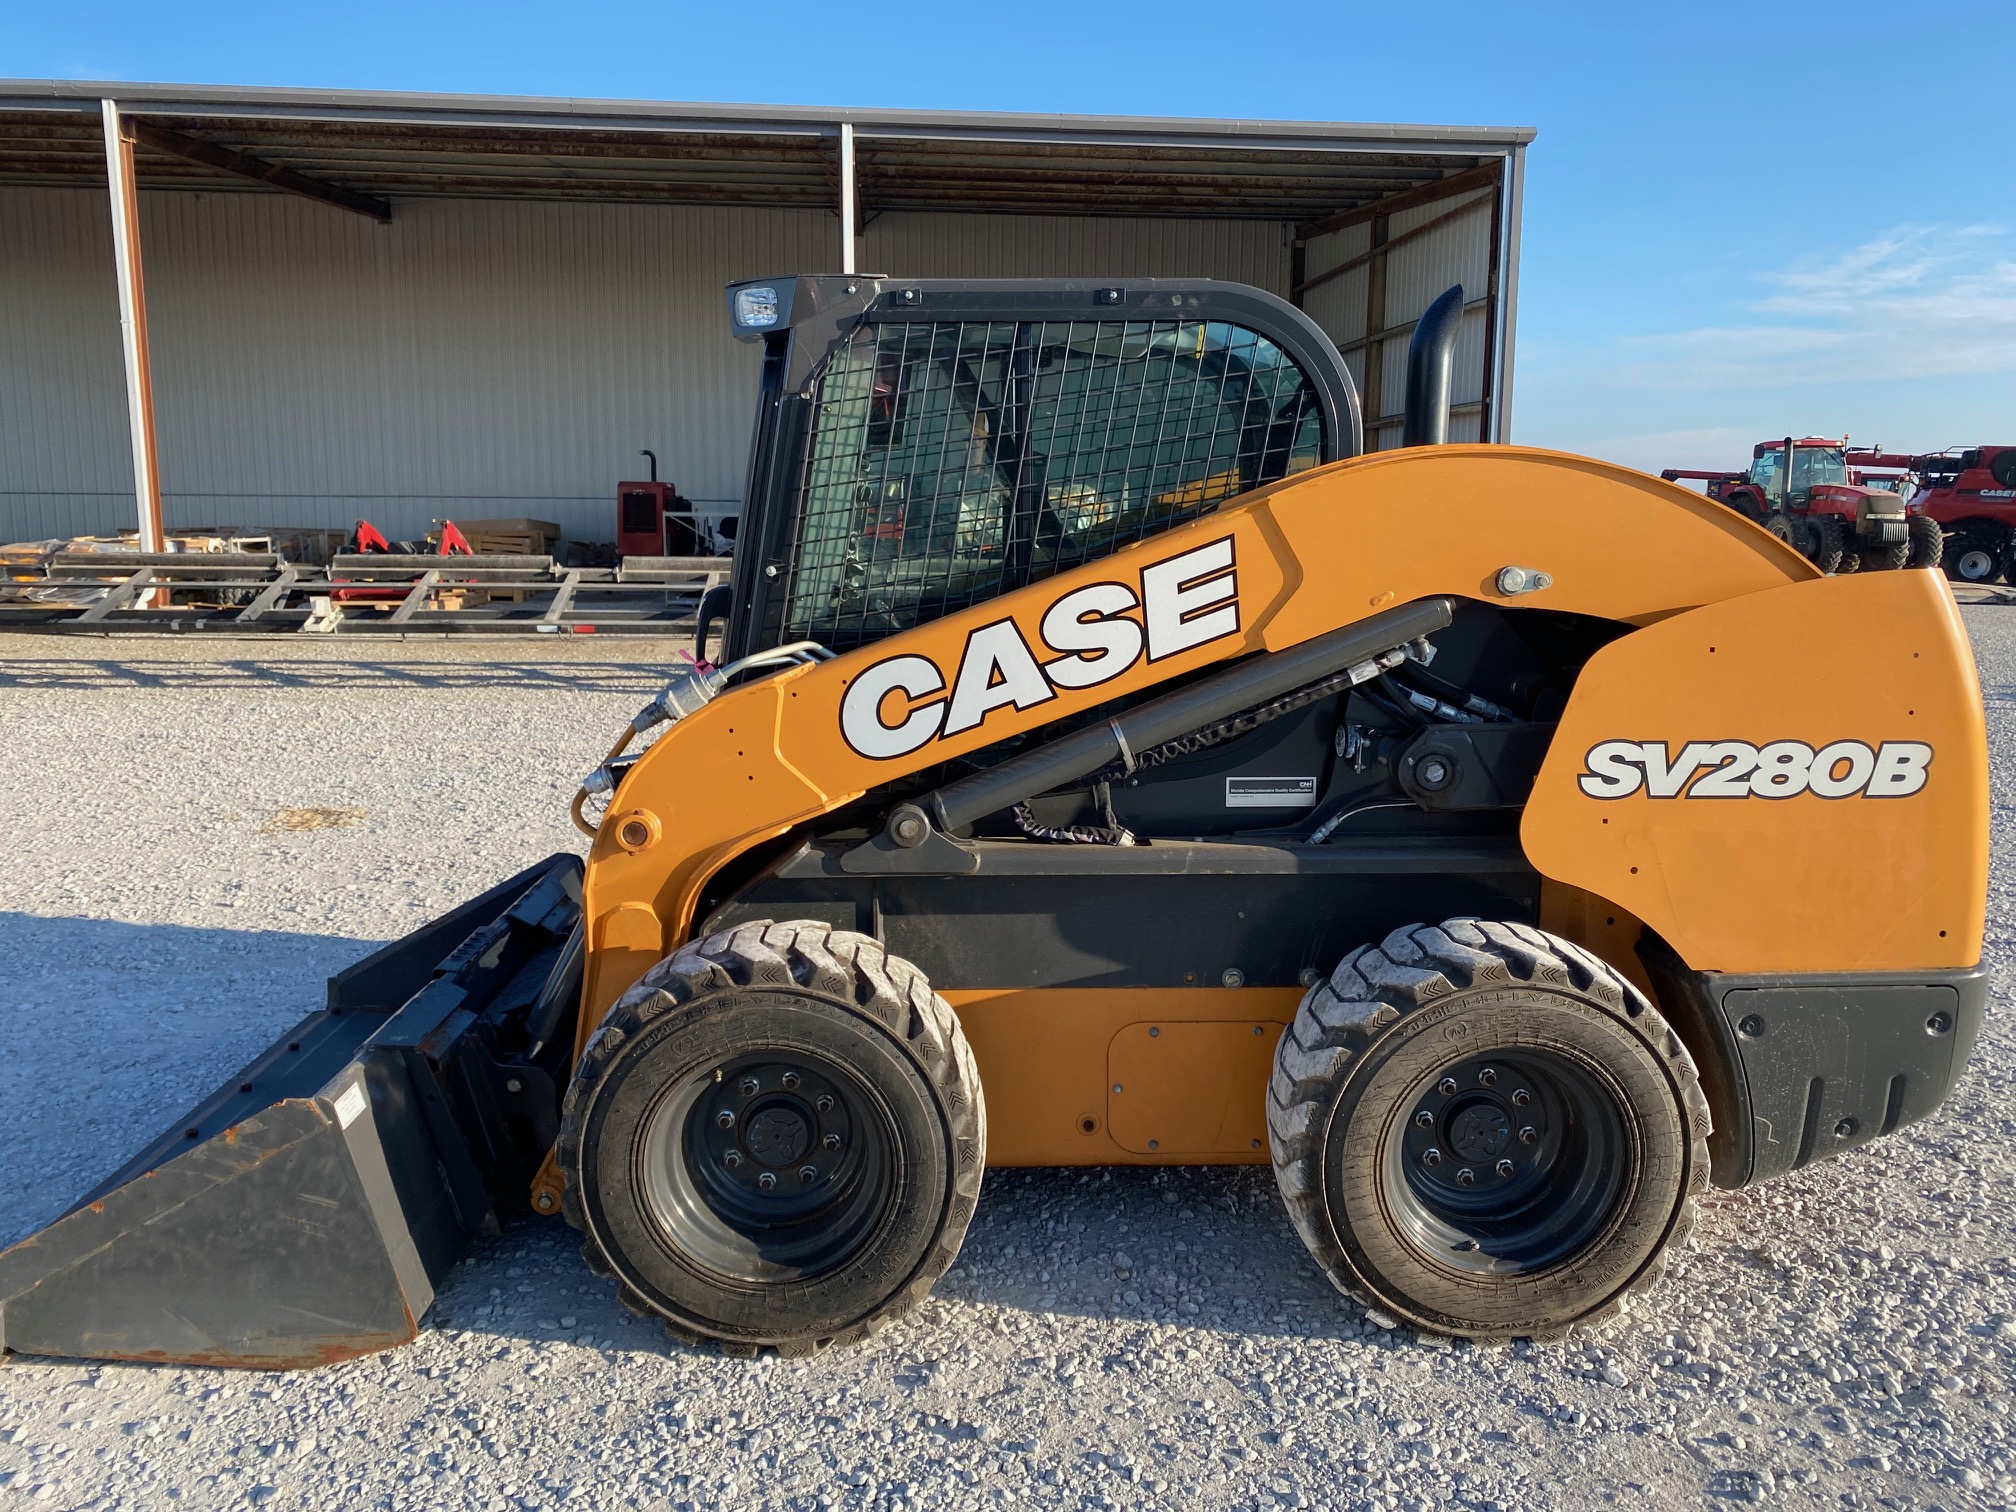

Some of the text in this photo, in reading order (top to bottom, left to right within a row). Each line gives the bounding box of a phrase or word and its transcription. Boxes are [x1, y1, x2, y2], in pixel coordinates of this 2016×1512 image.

[1980, 489, 2011, 497] CASE
[839, 533, 1241, 760] CASE
[1577, 738, 1935, 800] SV280B
